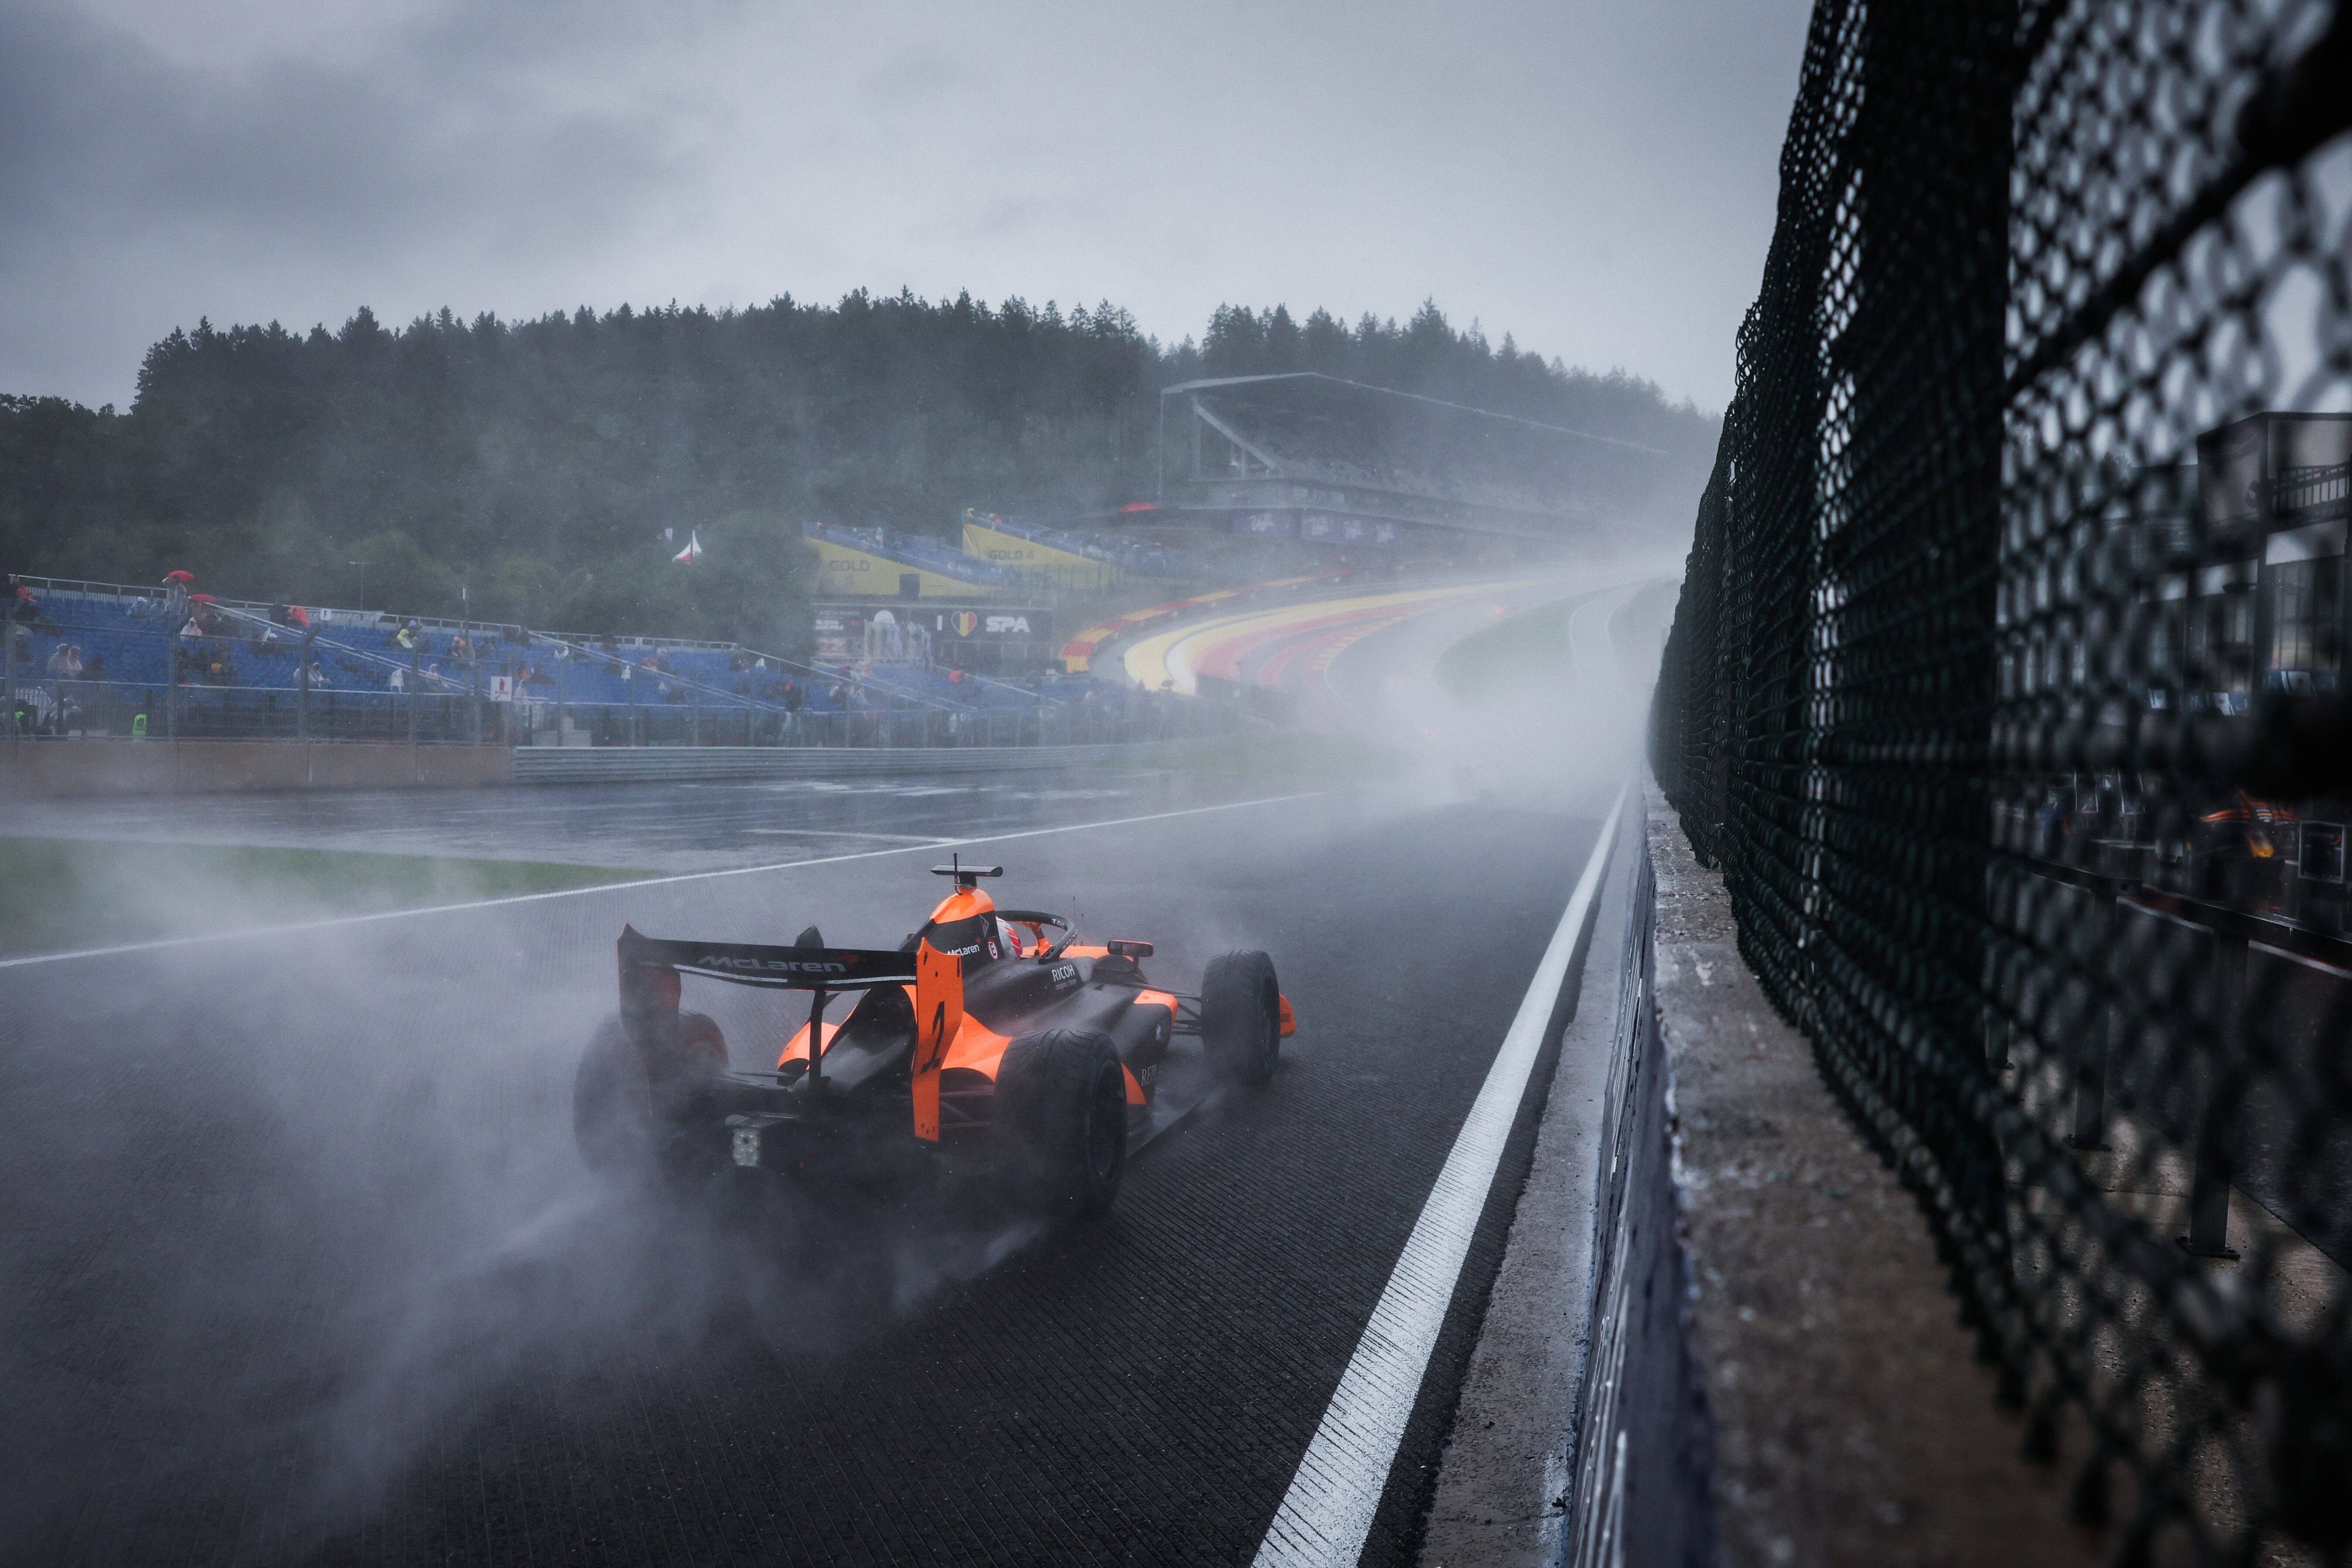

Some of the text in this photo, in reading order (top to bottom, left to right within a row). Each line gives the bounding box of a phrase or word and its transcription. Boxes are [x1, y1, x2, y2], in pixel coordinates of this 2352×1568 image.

[988, 550, 1023, 560] GOLD
[829, 560, 870, 571] GOLD
[937, 615, 1030, 633] I SPA
[699, 955, 846, 972] McLaren
[1051, 964, 1075, 982] RICOH
